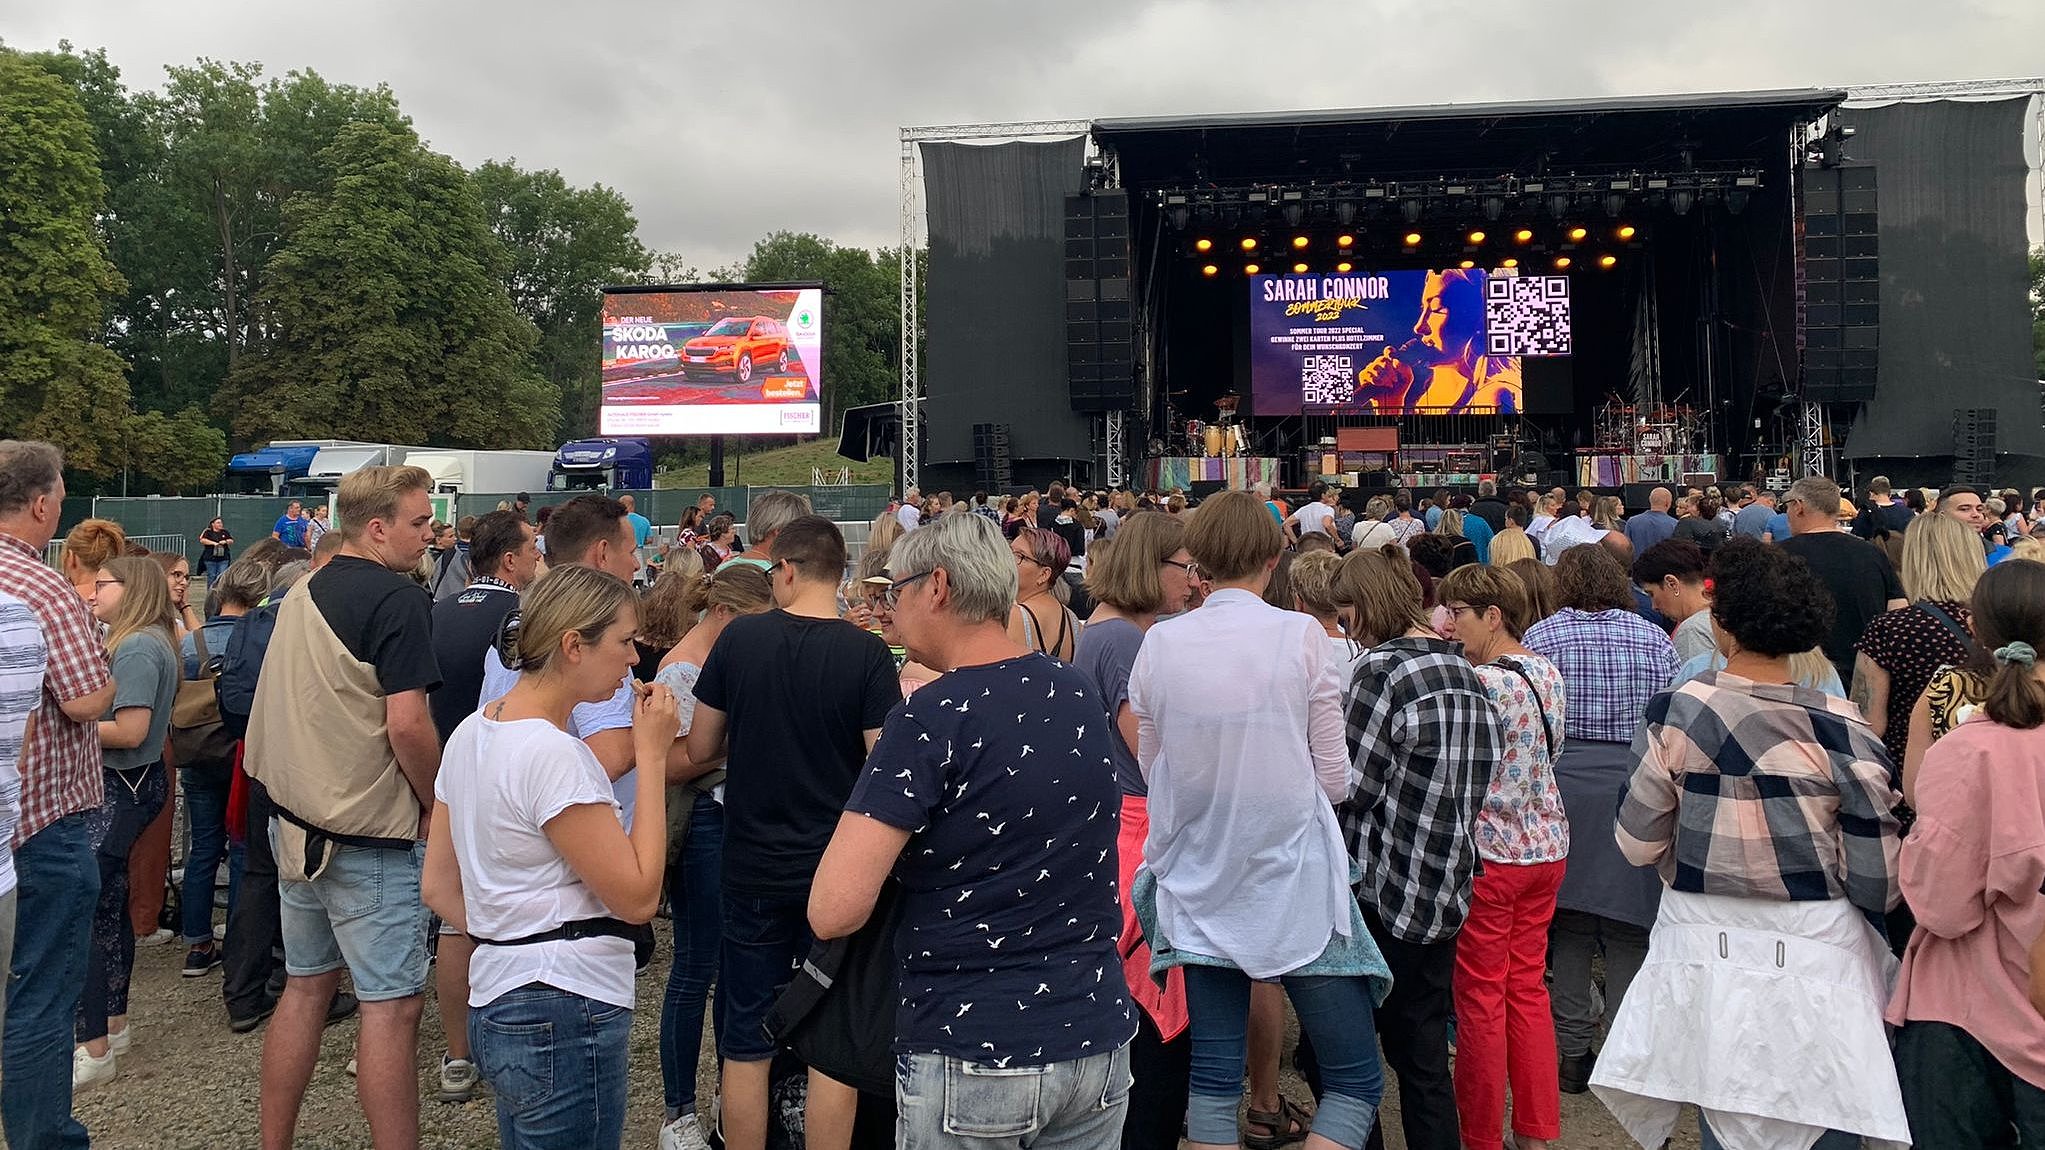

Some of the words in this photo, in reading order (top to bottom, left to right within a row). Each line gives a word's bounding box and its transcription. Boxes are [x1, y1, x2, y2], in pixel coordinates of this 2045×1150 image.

[1264, 279, 1317, 302] SARAH
[1323, 276, 1389, 300] CONNOR
[1315, 312, 1340, 322] 2022
